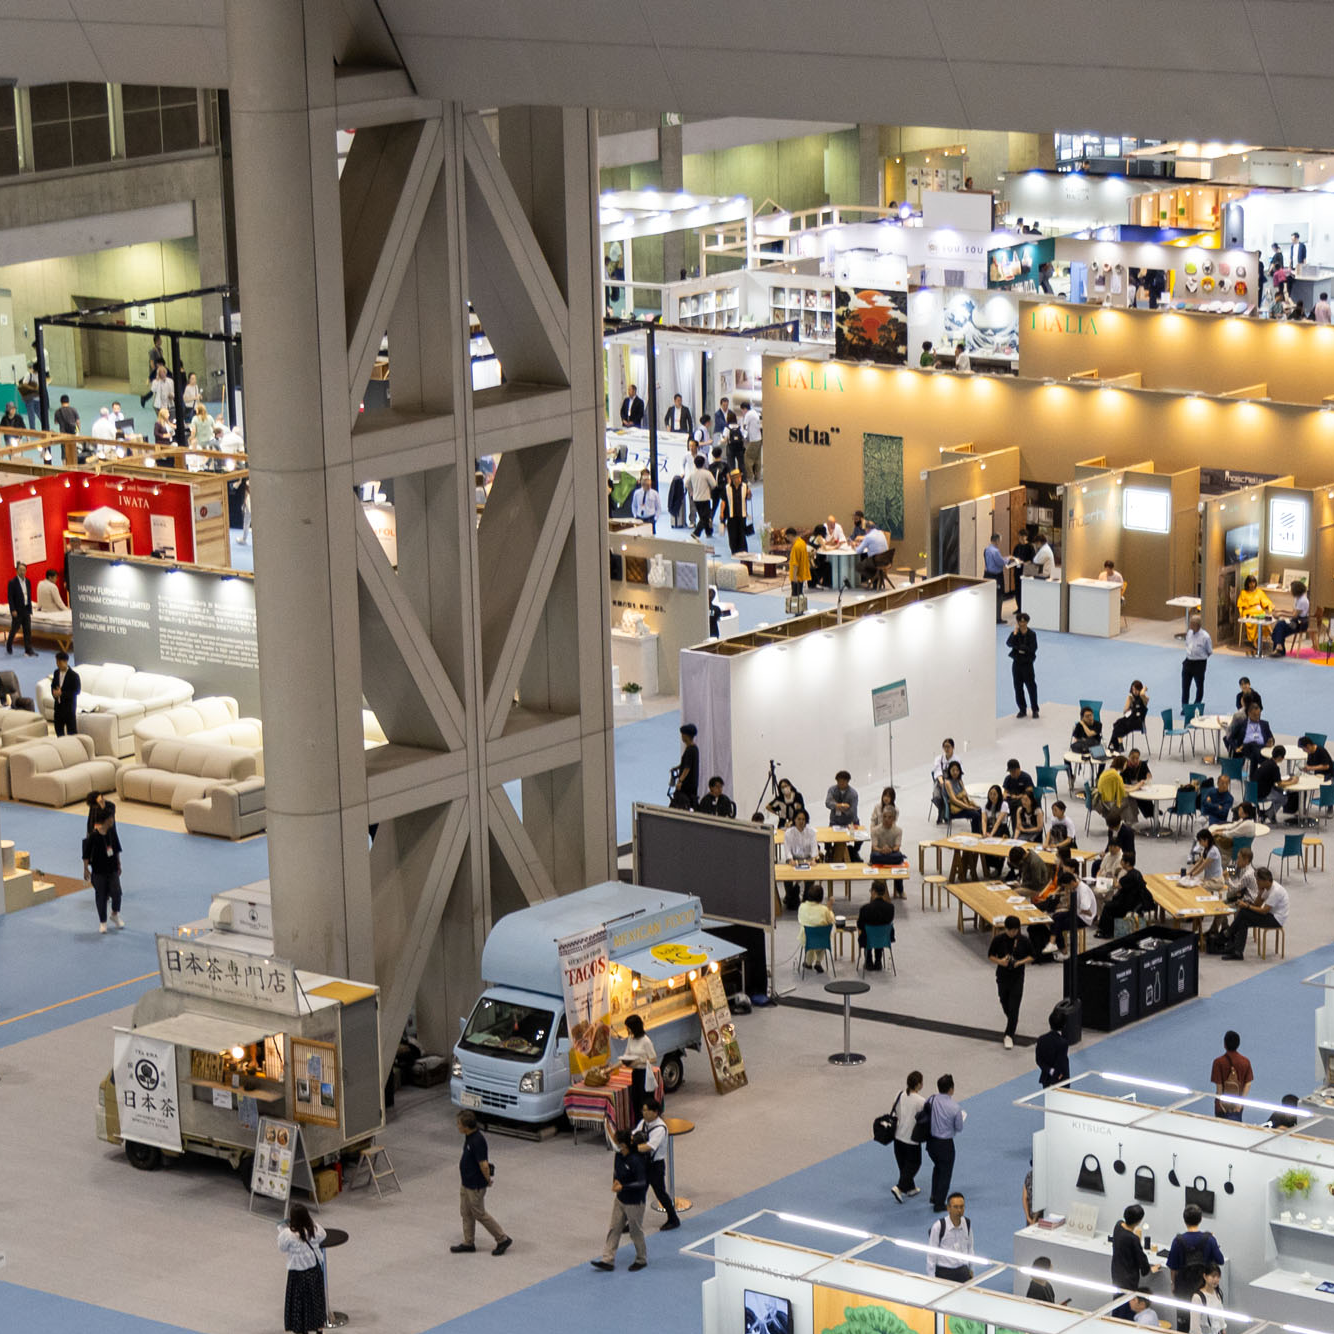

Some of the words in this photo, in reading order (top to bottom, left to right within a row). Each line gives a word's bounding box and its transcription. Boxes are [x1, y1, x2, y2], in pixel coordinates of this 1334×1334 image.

[118, 494, 150, 510] IWATA
[77, 585, 98, 594] HAPPY
[78, 594, 101, 604] VIETNAM
[102, 597, 129, 608] COMPANY
[129, 600, 151, 611] LIMITED
[80, 622, 106, 632] FURNITURE
[108, 616, 150, 629] INTERNATIONAL
[613, 920, 661, 948] MEXICAN
[665, 908, 695, 929] FOOD
[166, 950, 286, 993] 日本茶専門店
[564, 955, 606, 987] TACOS
[124, 1090, 176, 1118] 日本茶
